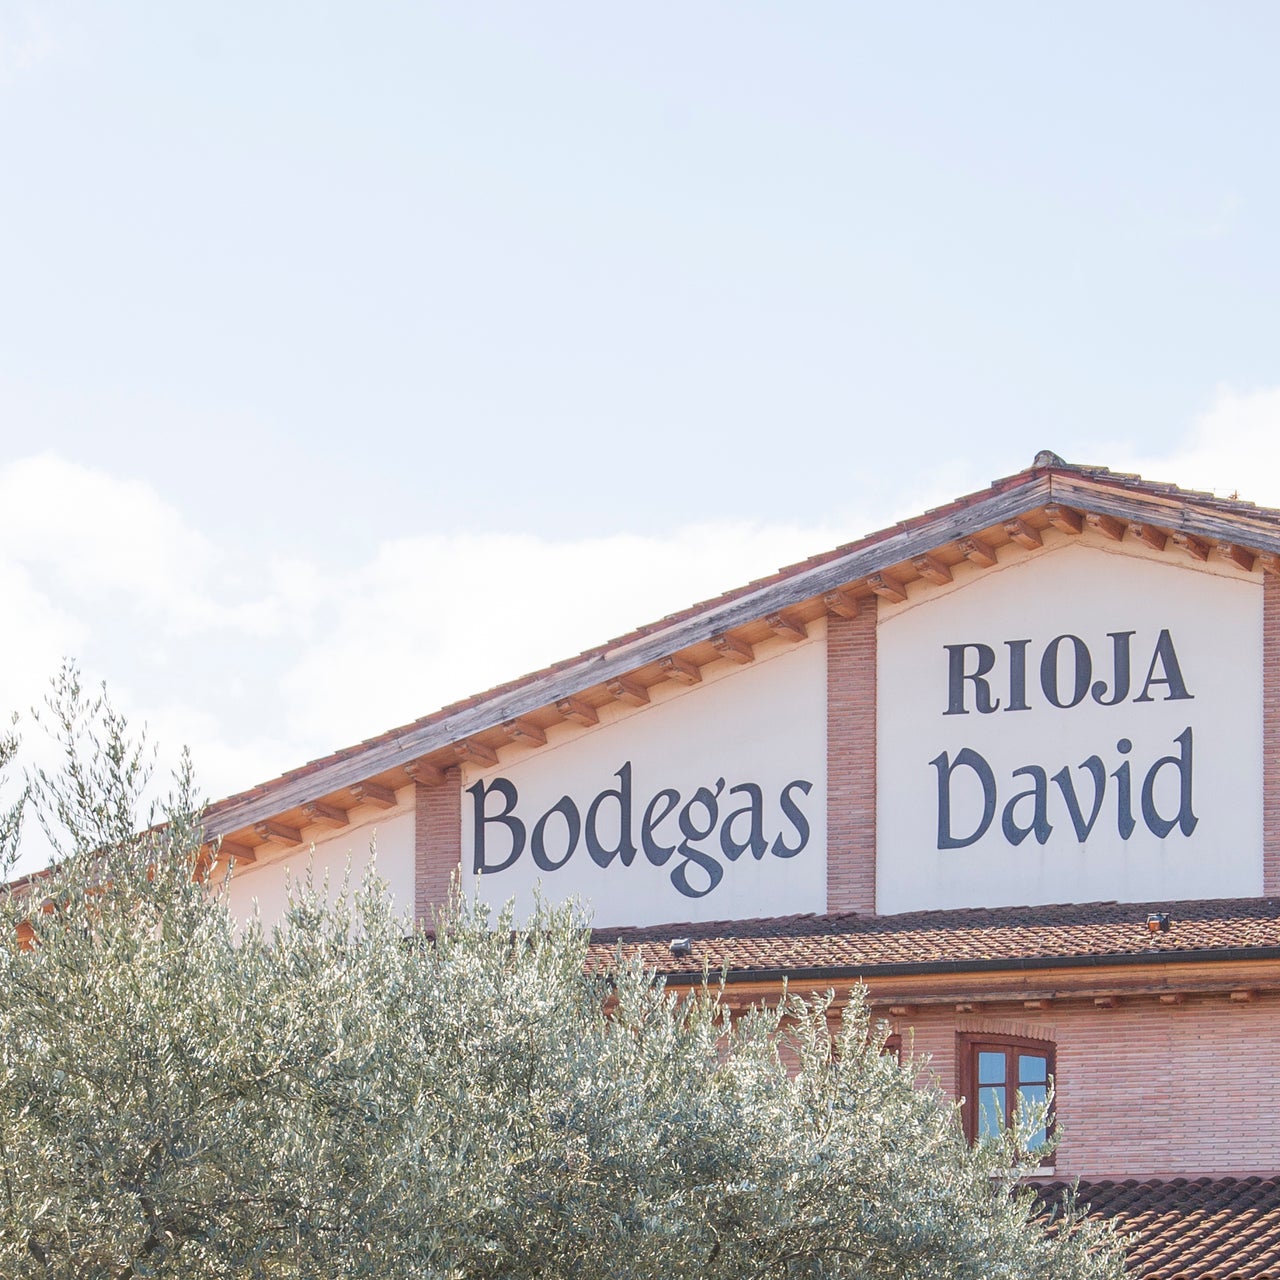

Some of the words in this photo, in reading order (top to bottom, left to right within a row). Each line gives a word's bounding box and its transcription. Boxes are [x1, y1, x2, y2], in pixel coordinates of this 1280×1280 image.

[942, 628, 1195, 716] RIOJA
[465, 760, 813, 899] Bodegas
[928, 726, 1199, 850] David
